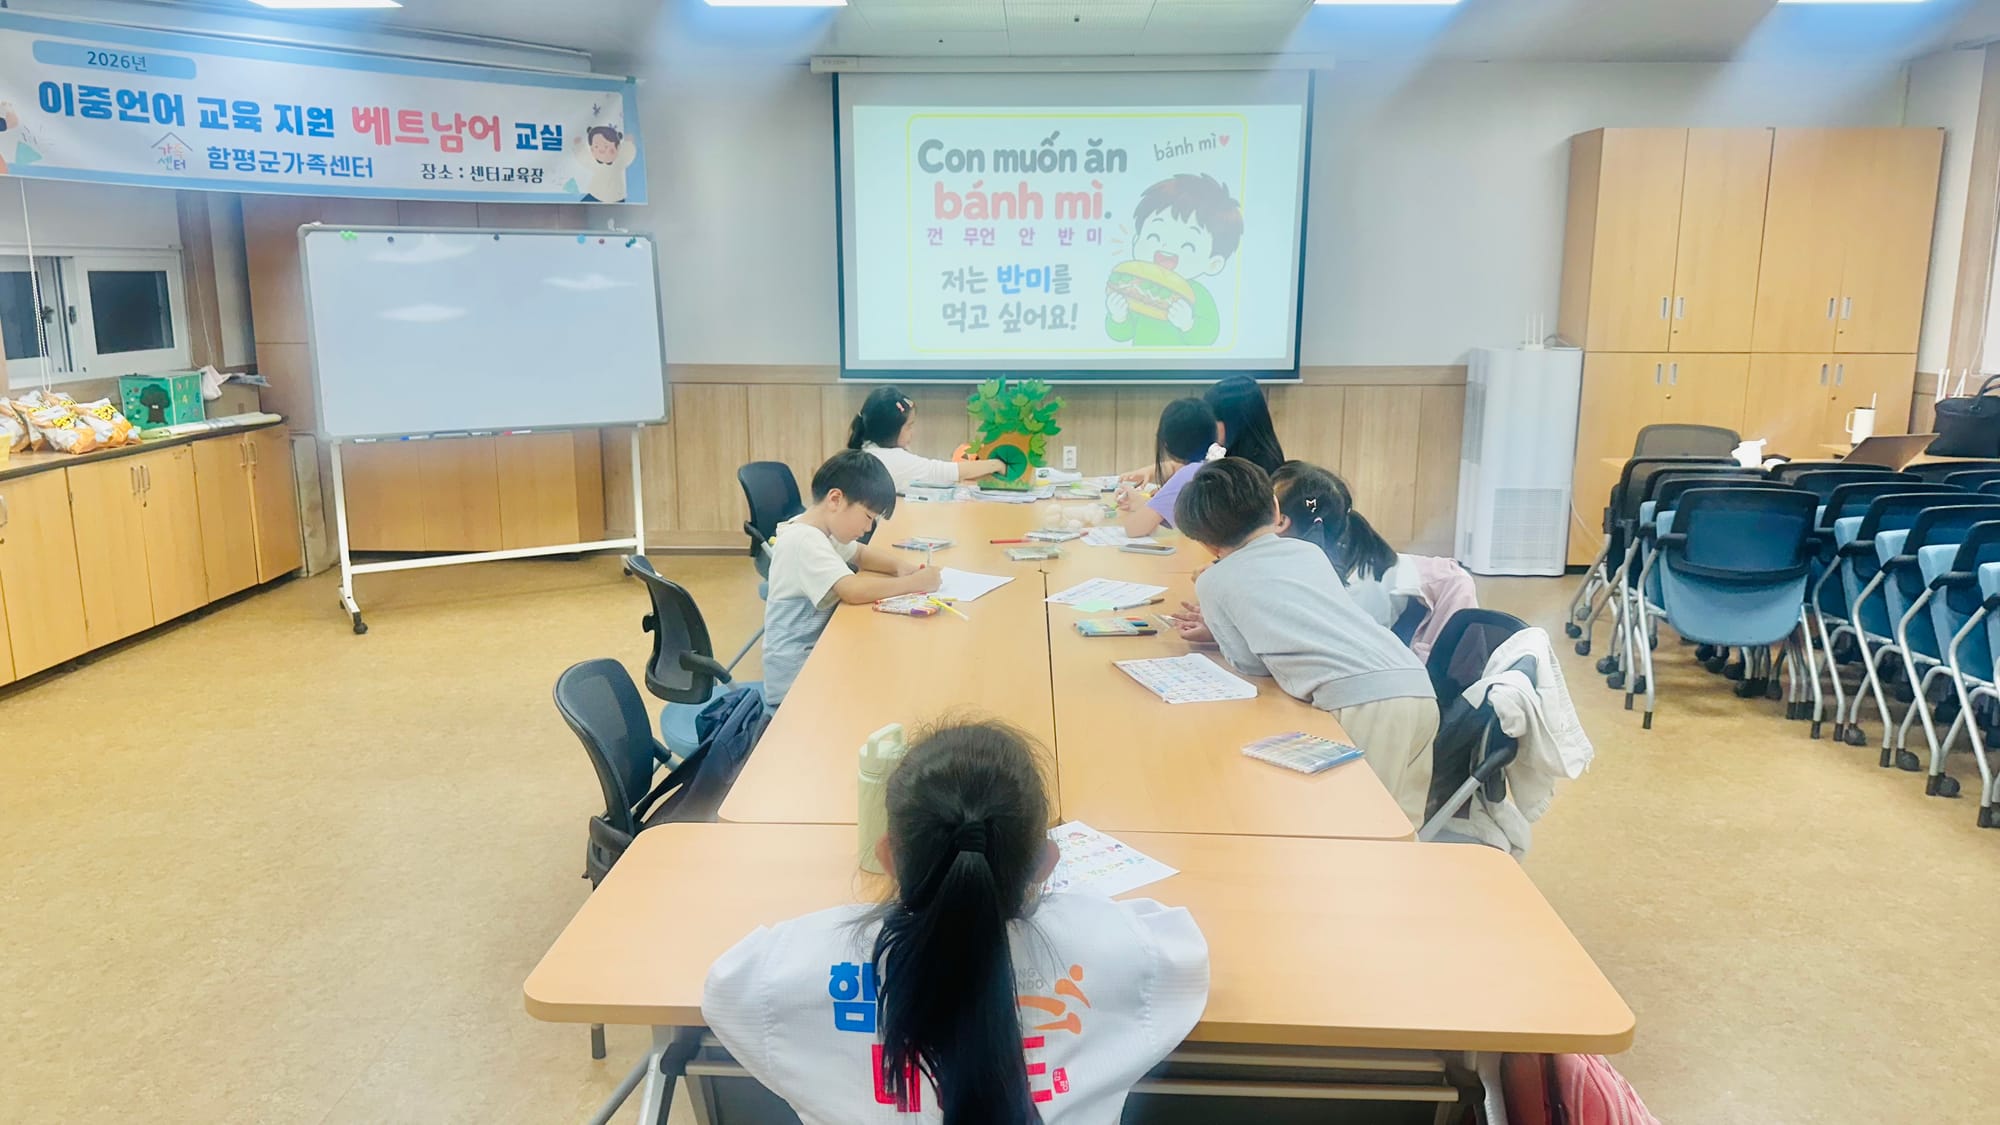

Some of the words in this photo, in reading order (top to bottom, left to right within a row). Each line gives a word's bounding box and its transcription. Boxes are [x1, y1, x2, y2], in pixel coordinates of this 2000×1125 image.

[86, 51, 147, 72] 2026년
[38, 80, 186, 127] 이중언어
[197, 96, 262, 133] 교육
[274, 103, 335, 138] 지원
[351, 106, 501, 153] 베트남어
[515, 122, 563, 152] 교실
[157, 155, 187, 171] 센터
[206, 145, 374, 179] 함평군가족센터
[917, 138, 985, 173] Con
[993, 130, 1078, 173] muốn
[1083, 137, 1128, 173] ăn
[1154, 136, 1195, 162] bánh
[1198, 132, 1218, 151] mì
[420, 162, 454, 180] 장소
[469, 165, 545, 185] 센터교육장
[934, 179, 1044, 220] bánh
[1054, 178, 1113, 220] mì.
[927, 227, 944, 246] 껀
[963, 227, 996, 246] 무언
[1018, 227, 1036, 246] 안
[1058, 227, 1075, 246] 반
[1086, 227, 1103, 246] 미
[941, 265, 989, 295] 저는
[996, 263, 1073, 295] 반미를
[941, 301, 990, 333] 먹고
[998, 301, 1079, 334] 싶어요!
